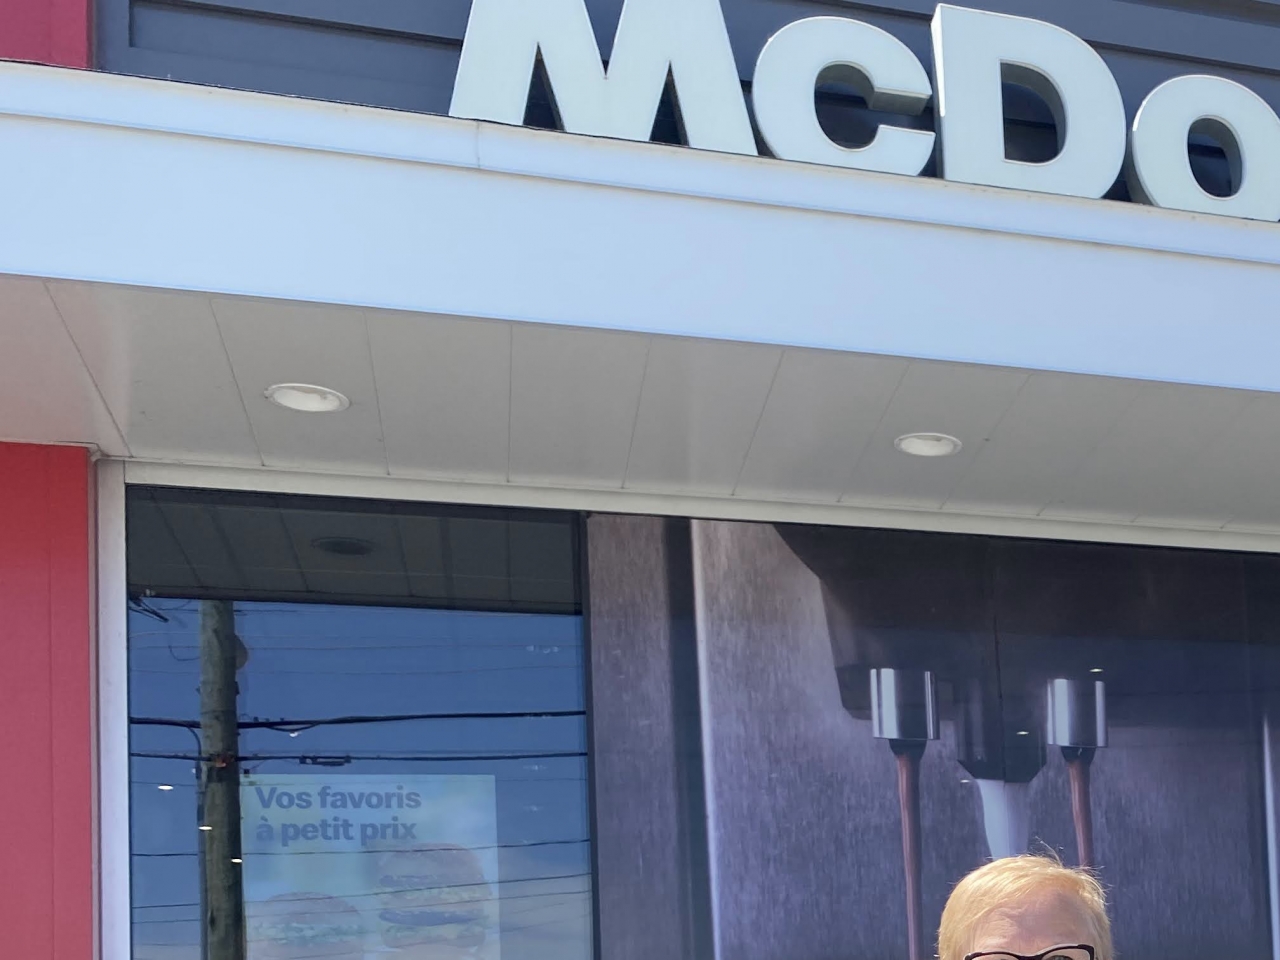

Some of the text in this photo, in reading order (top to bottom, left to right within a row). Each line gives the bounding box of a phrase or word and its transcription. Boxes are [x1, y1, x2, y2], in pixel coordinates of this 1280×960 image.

[255, 785, 422, 809] Vos favoris
[256, 816, 417, 847] à petit prix
